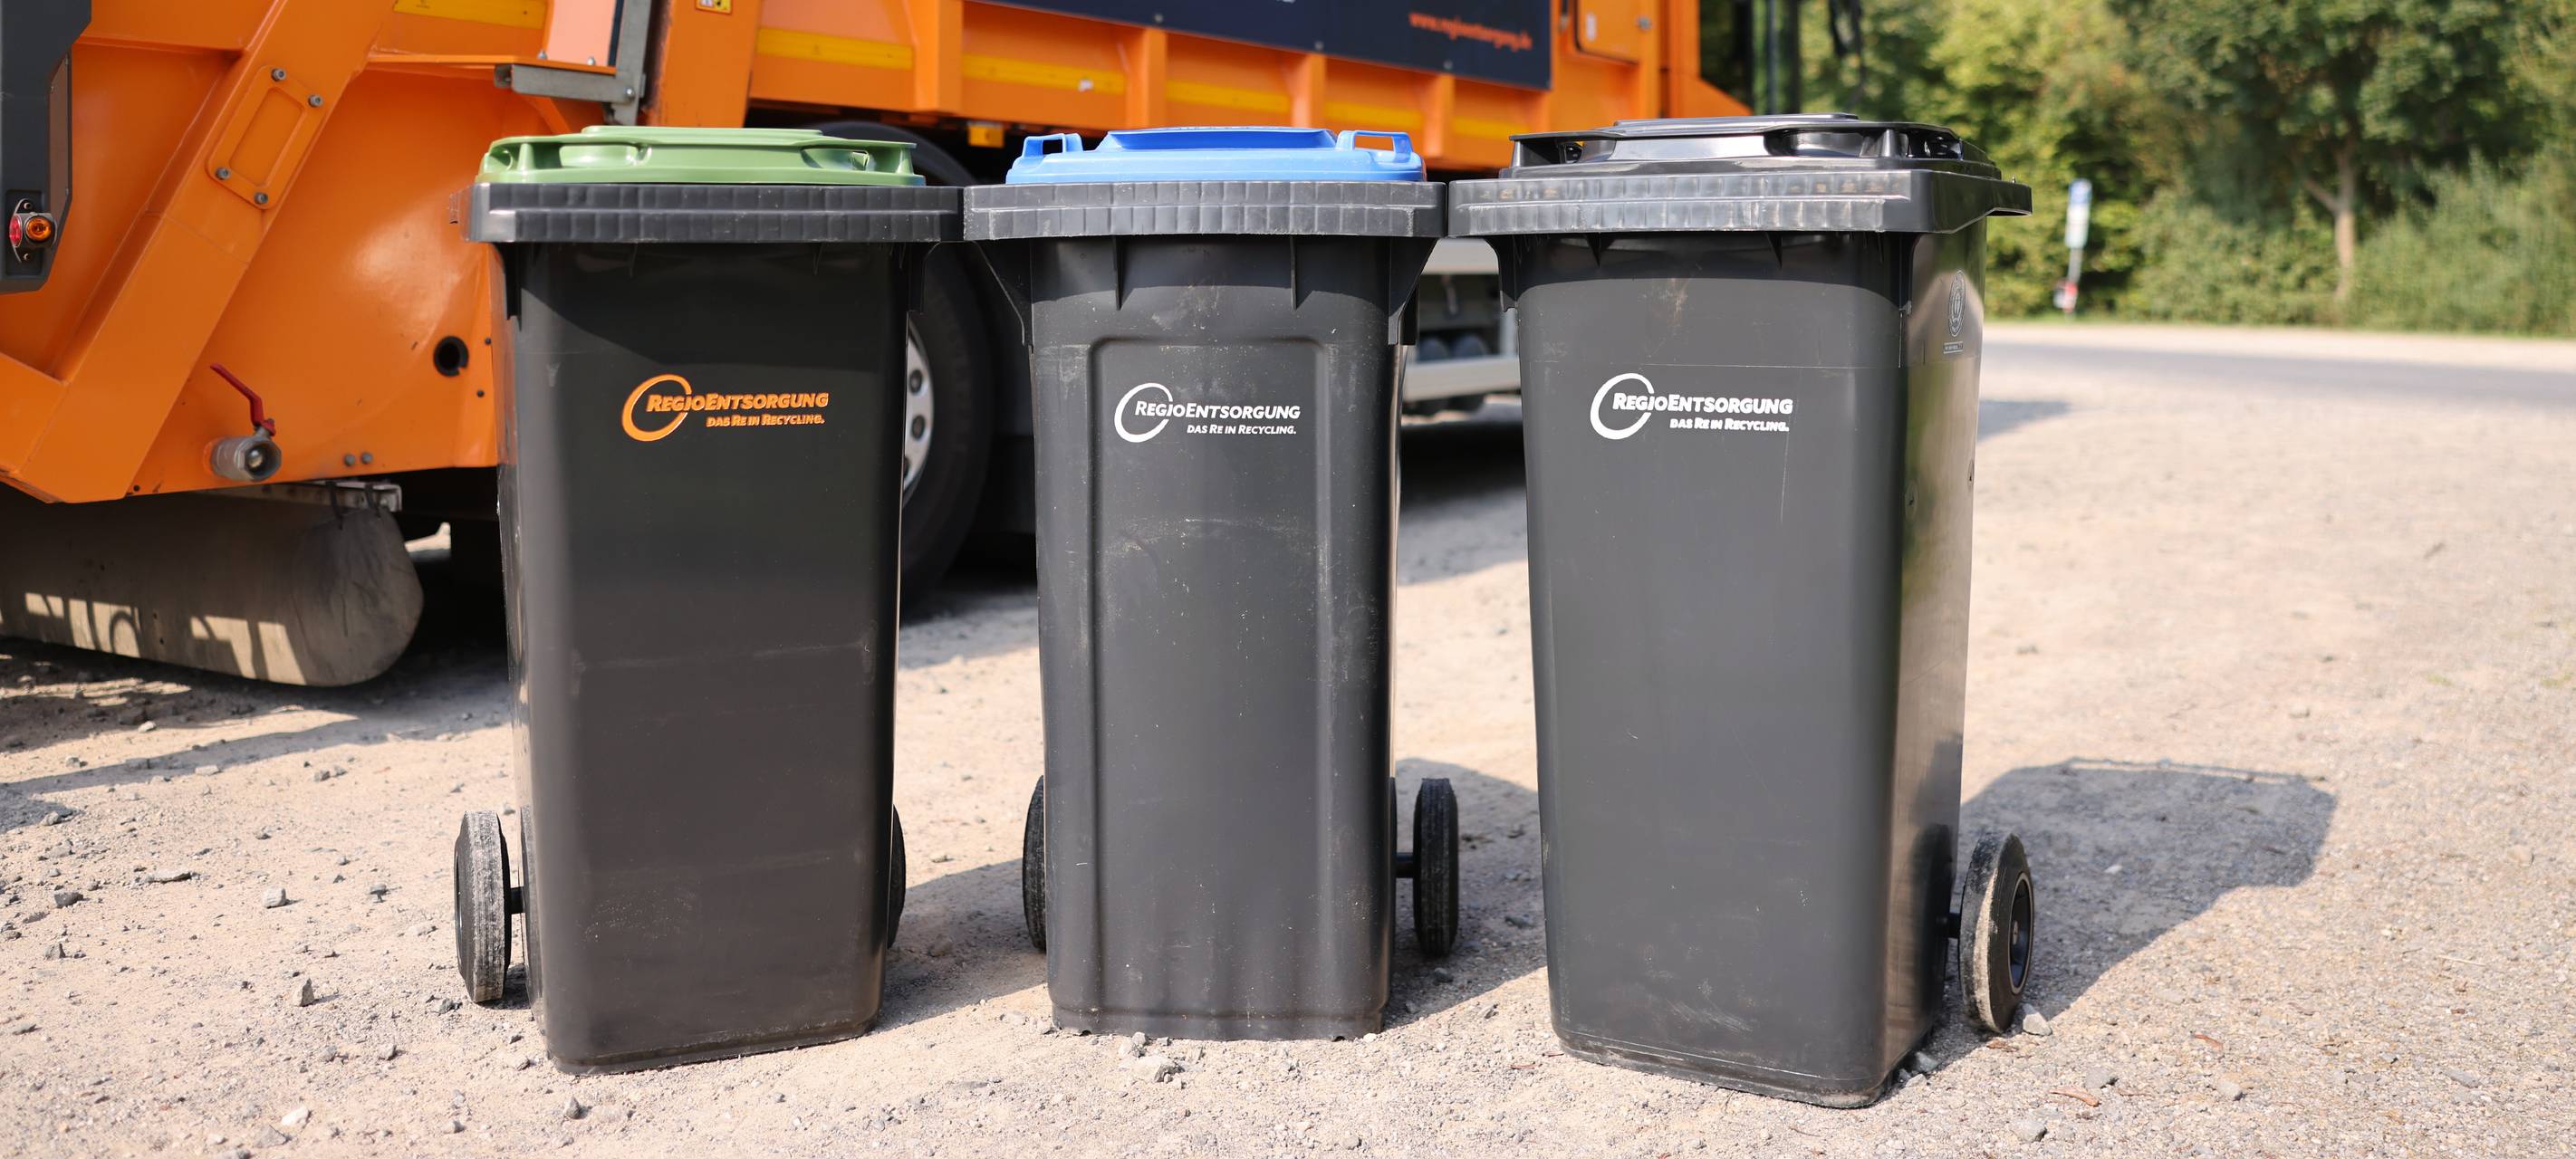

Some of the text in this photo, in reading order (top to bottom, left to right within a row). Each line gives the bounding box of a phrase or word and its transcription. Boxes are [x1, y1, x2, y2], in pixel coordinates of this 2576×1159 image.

[647, 393, 828, 411] REGIOENTSORGUNG
[1135, 400, 1301, 419] REGIOENTSORGUNG
[1612, 393, 1793, 414] REGIOENTSORGUNG
[706, 417, 730, 426] DAS
[761, 414, 825, 426] RECYCLING.
[1669, 418, 1693, 428] DAS
[1694, 417, 1710, 429] RE
[1724, 417, 1790, 432] RECYCLING.
[1187, 424, 1296, 435] DAS RE IN RECYCLING.
